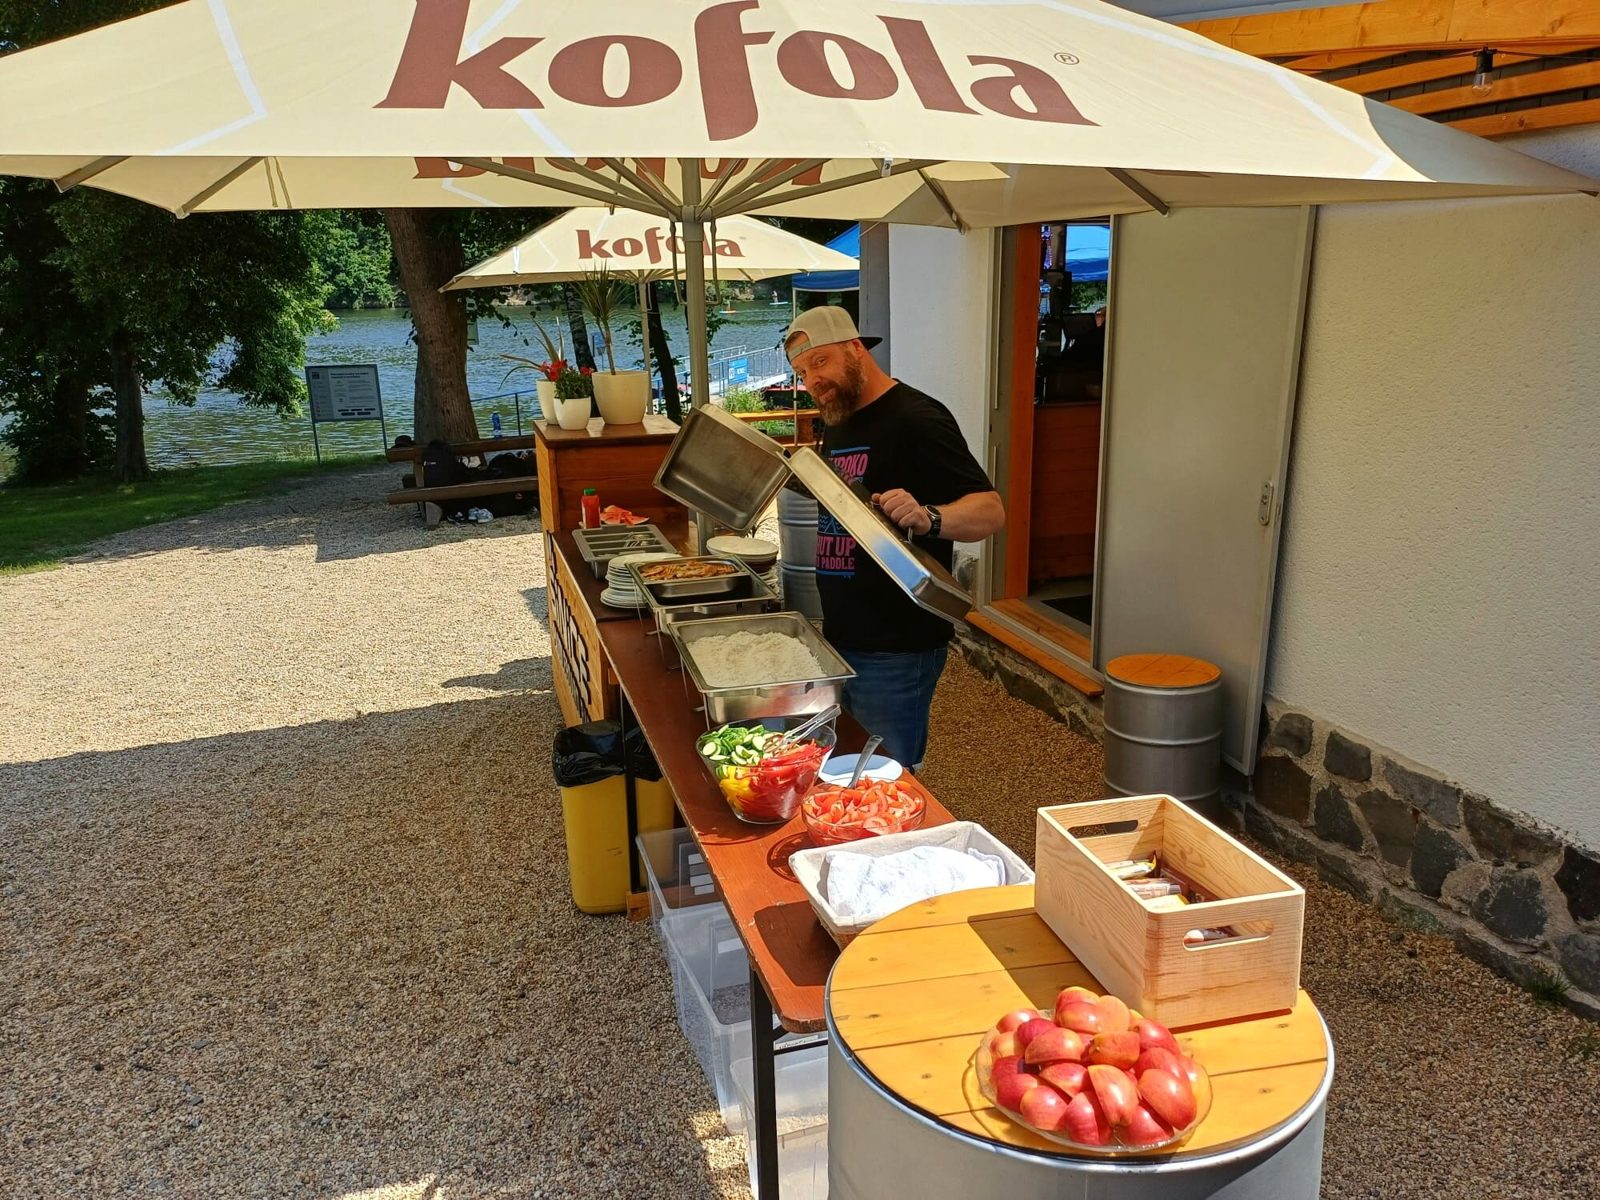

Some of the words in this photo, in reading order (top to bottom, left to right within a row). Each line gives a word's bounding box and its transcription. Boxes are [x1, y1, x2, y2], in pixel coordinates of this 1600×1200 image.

[372, 0, 1100, 141] kofola
[835, 536, 856, 557] UP
[821, 557, 855, 570] PADDLE
